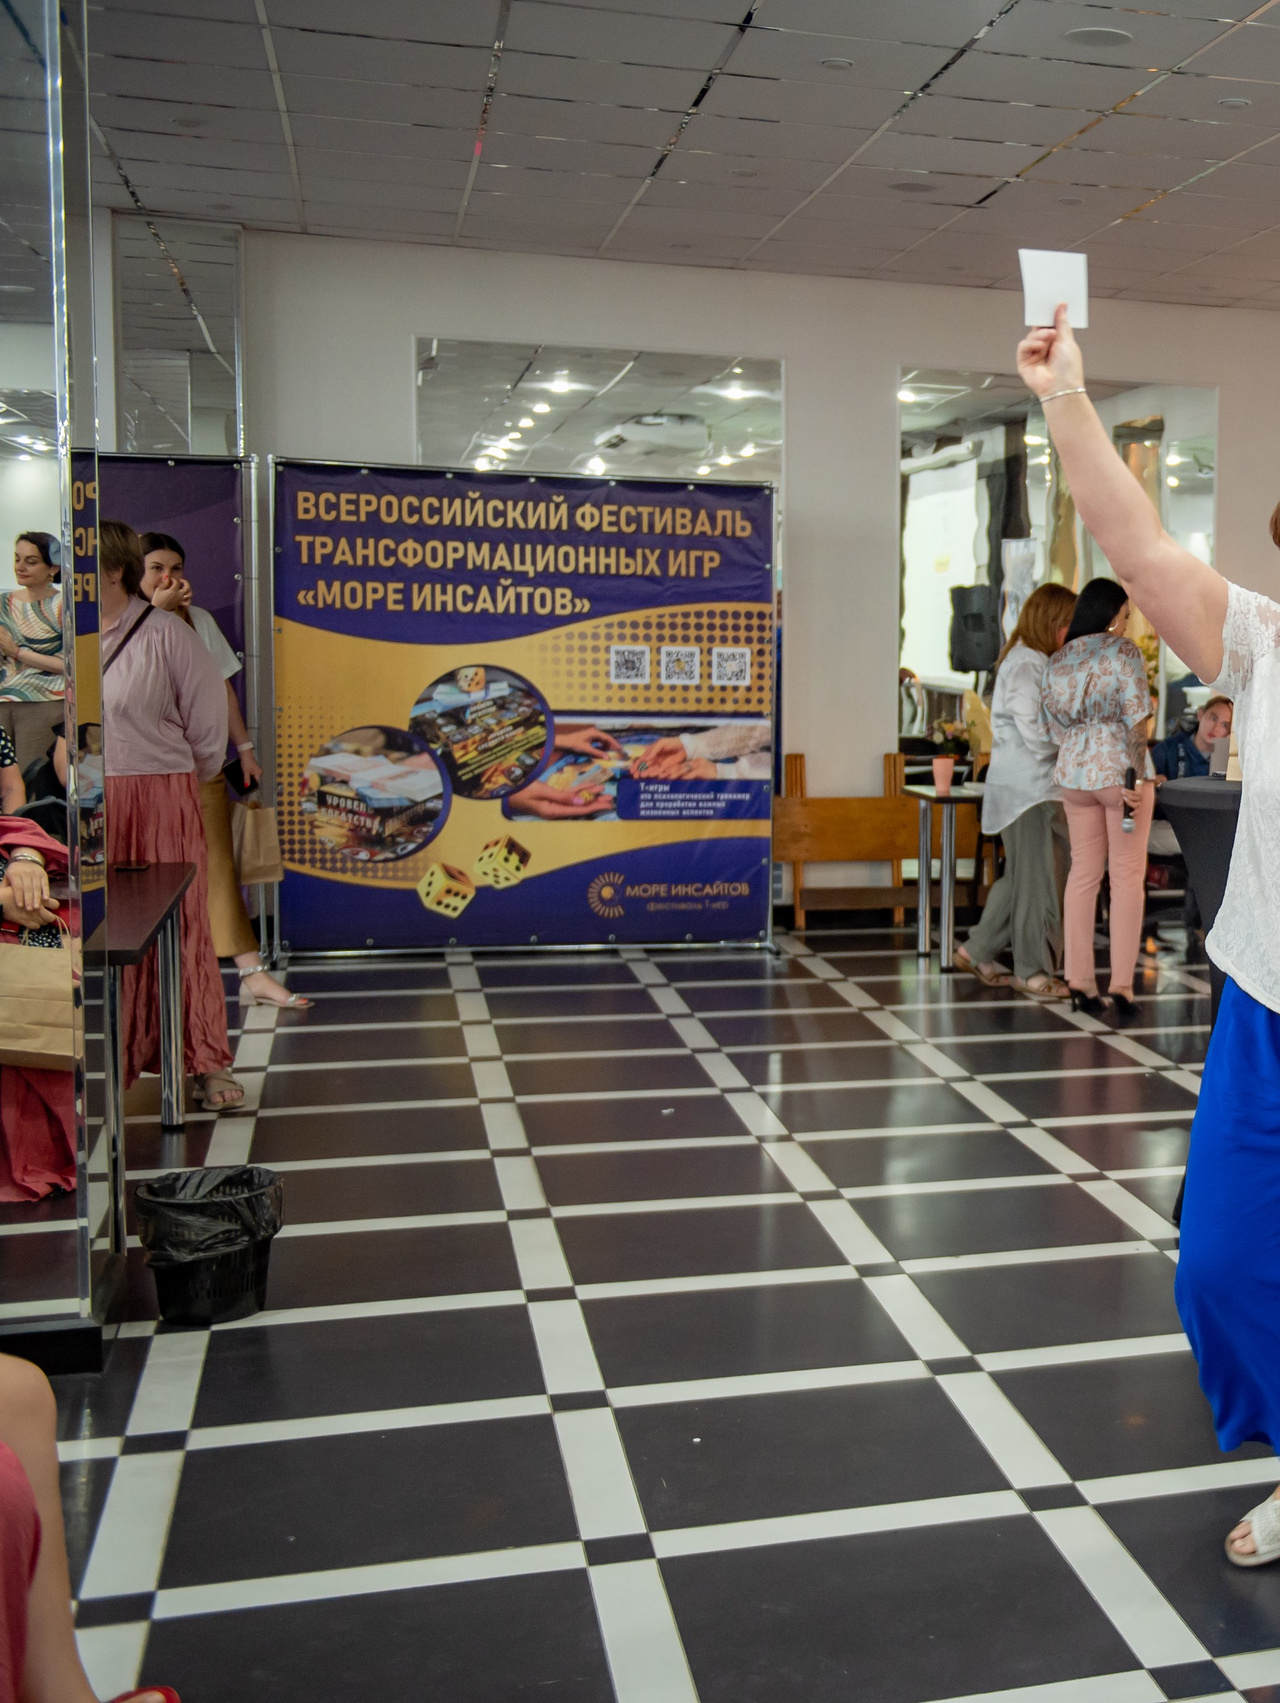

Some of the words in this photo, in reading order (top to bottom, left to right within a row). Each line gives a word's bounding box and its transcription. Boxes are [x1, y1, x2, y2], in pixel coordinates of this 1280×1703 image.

[296, 490, 569, 531] ВСЕРОССИЙСКИЙ
[575, 502, 753, 538] ФЕСТИВАЛЬ
[295, 534, 662, 578] ТРАНСФОРМАЦИОННЫХ
[667, 549, 722, 578] ИГР
[297, 579, 405, 611] «МОРЕ
[412, 577, 591, 615] ИНСАЙТОВ»
[640, 782, 670, 793] Т-игры
[653, 791, 715, 801] психологический
[640, 801, 654, 809] для
[625, 883, 668, 897] МОРЕ
[671, 880, 750, 897] ИНСАЙТОВ
